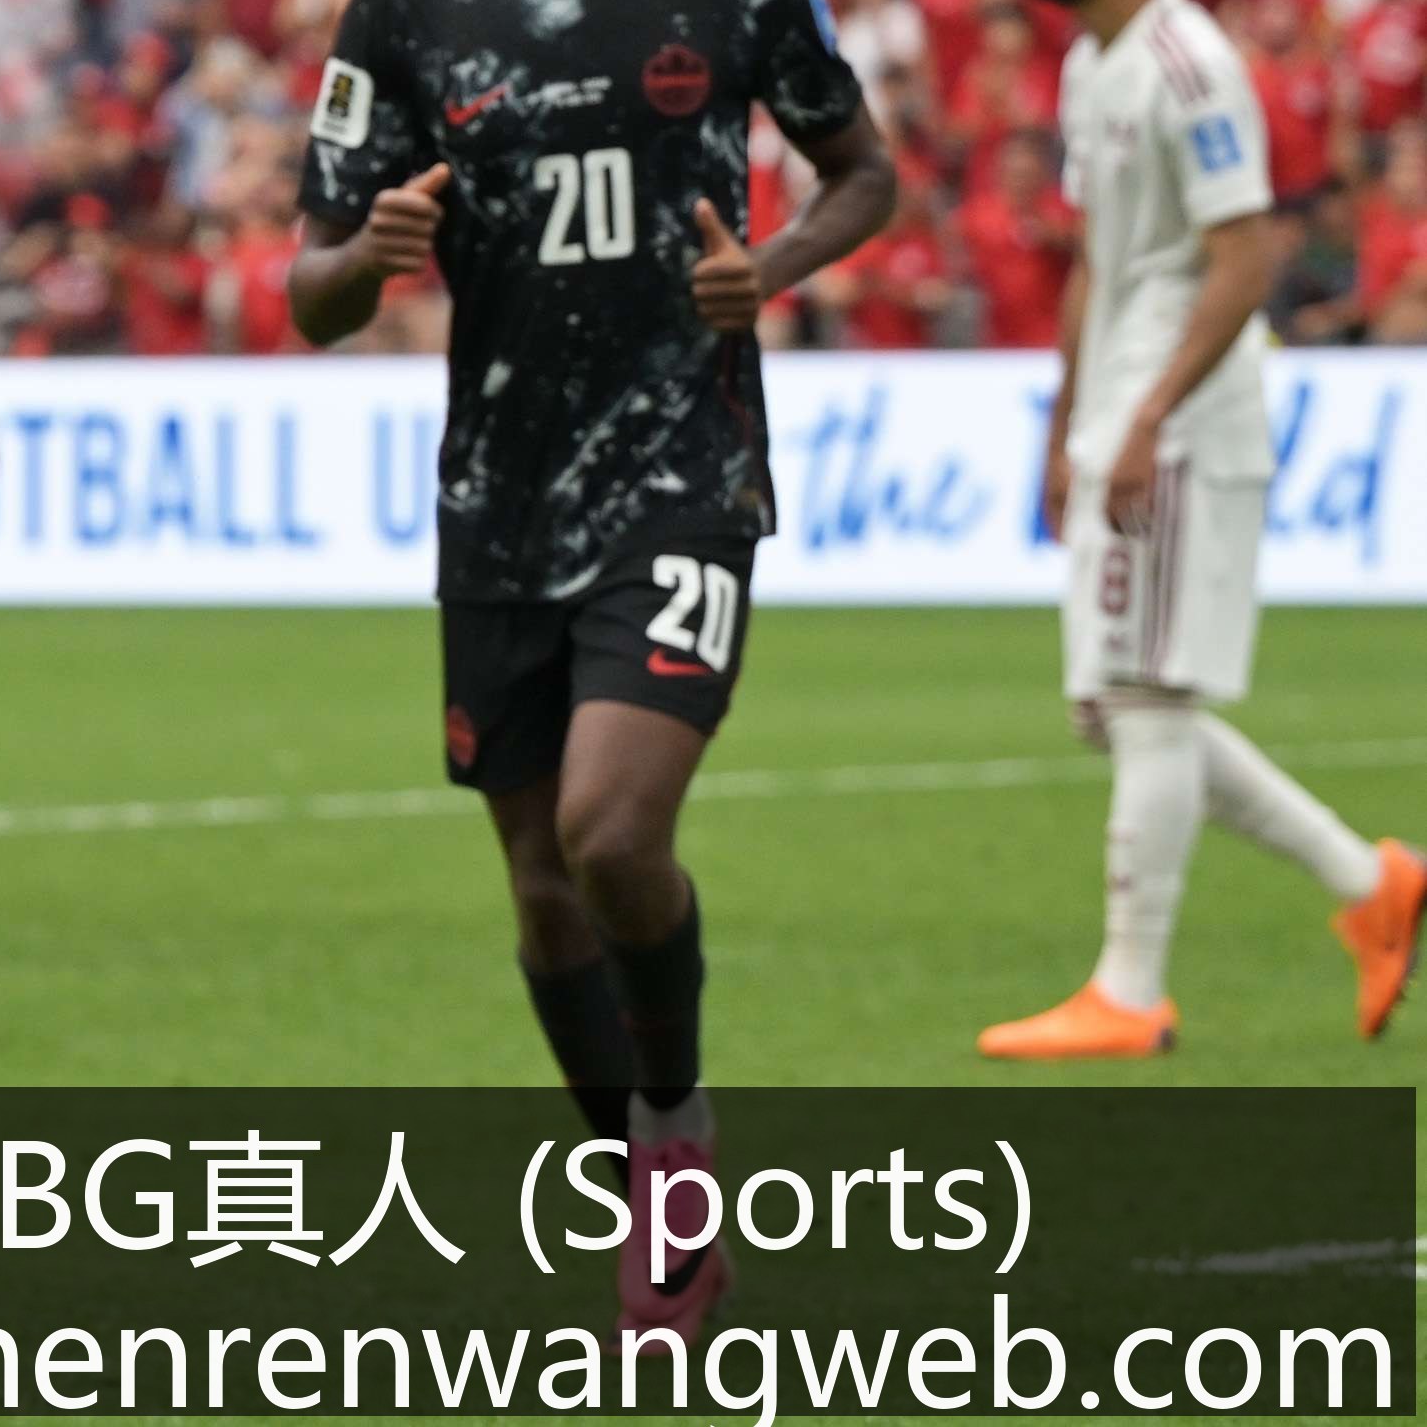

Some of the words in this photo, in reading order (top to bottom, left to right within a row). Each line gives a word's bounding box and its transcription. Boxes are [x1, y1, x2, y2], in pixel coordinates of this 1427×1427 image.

[535, 148, 635, 266] 20
[783, 380, 995, 554] the
[647, 554, 739, 673] 20
